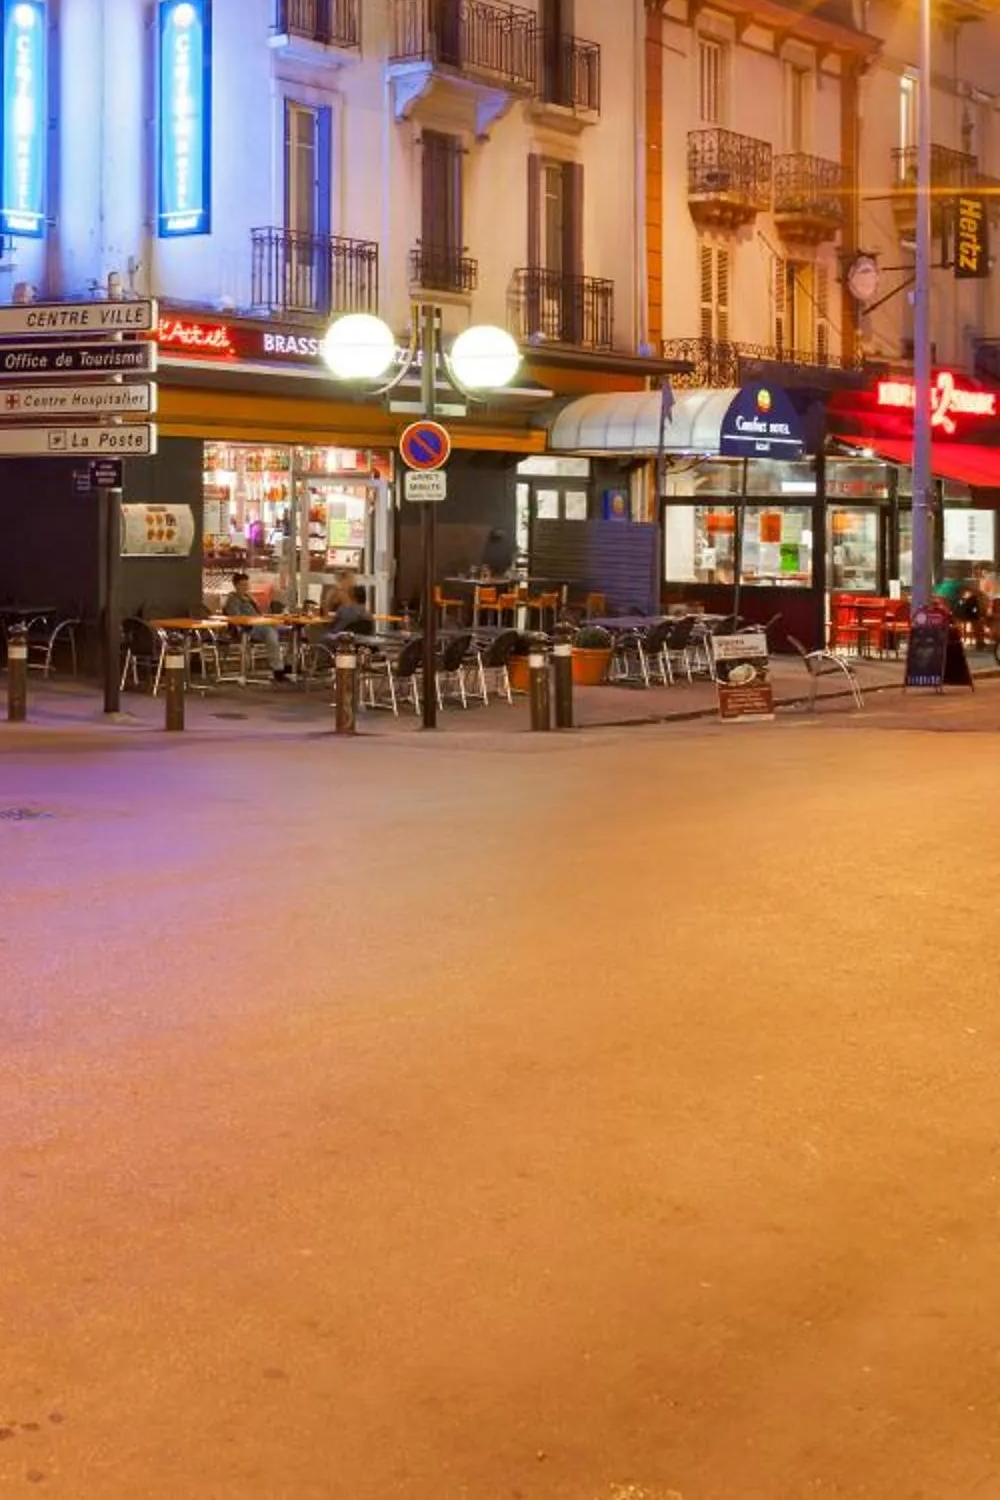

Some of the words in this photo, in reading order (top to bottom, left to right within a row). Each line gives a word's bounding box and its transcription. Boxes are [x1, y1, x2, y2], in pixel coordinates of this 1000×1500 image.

[959, 197, 983, 272] Hertz
[26, 310, 89, 328] CENTRE
[100, 307, 145, 324] VILLE
[4, 352, 48, 370] Office
[55, 351, 73, 367] de
[80, 349, 144, 366] Tourisme
[23, 393, 67, 407] Centre
[71, 391, 145, 408] Hospitalier
[71, 431, 90, 448] La
[99, 431, 144, 448] Poste
